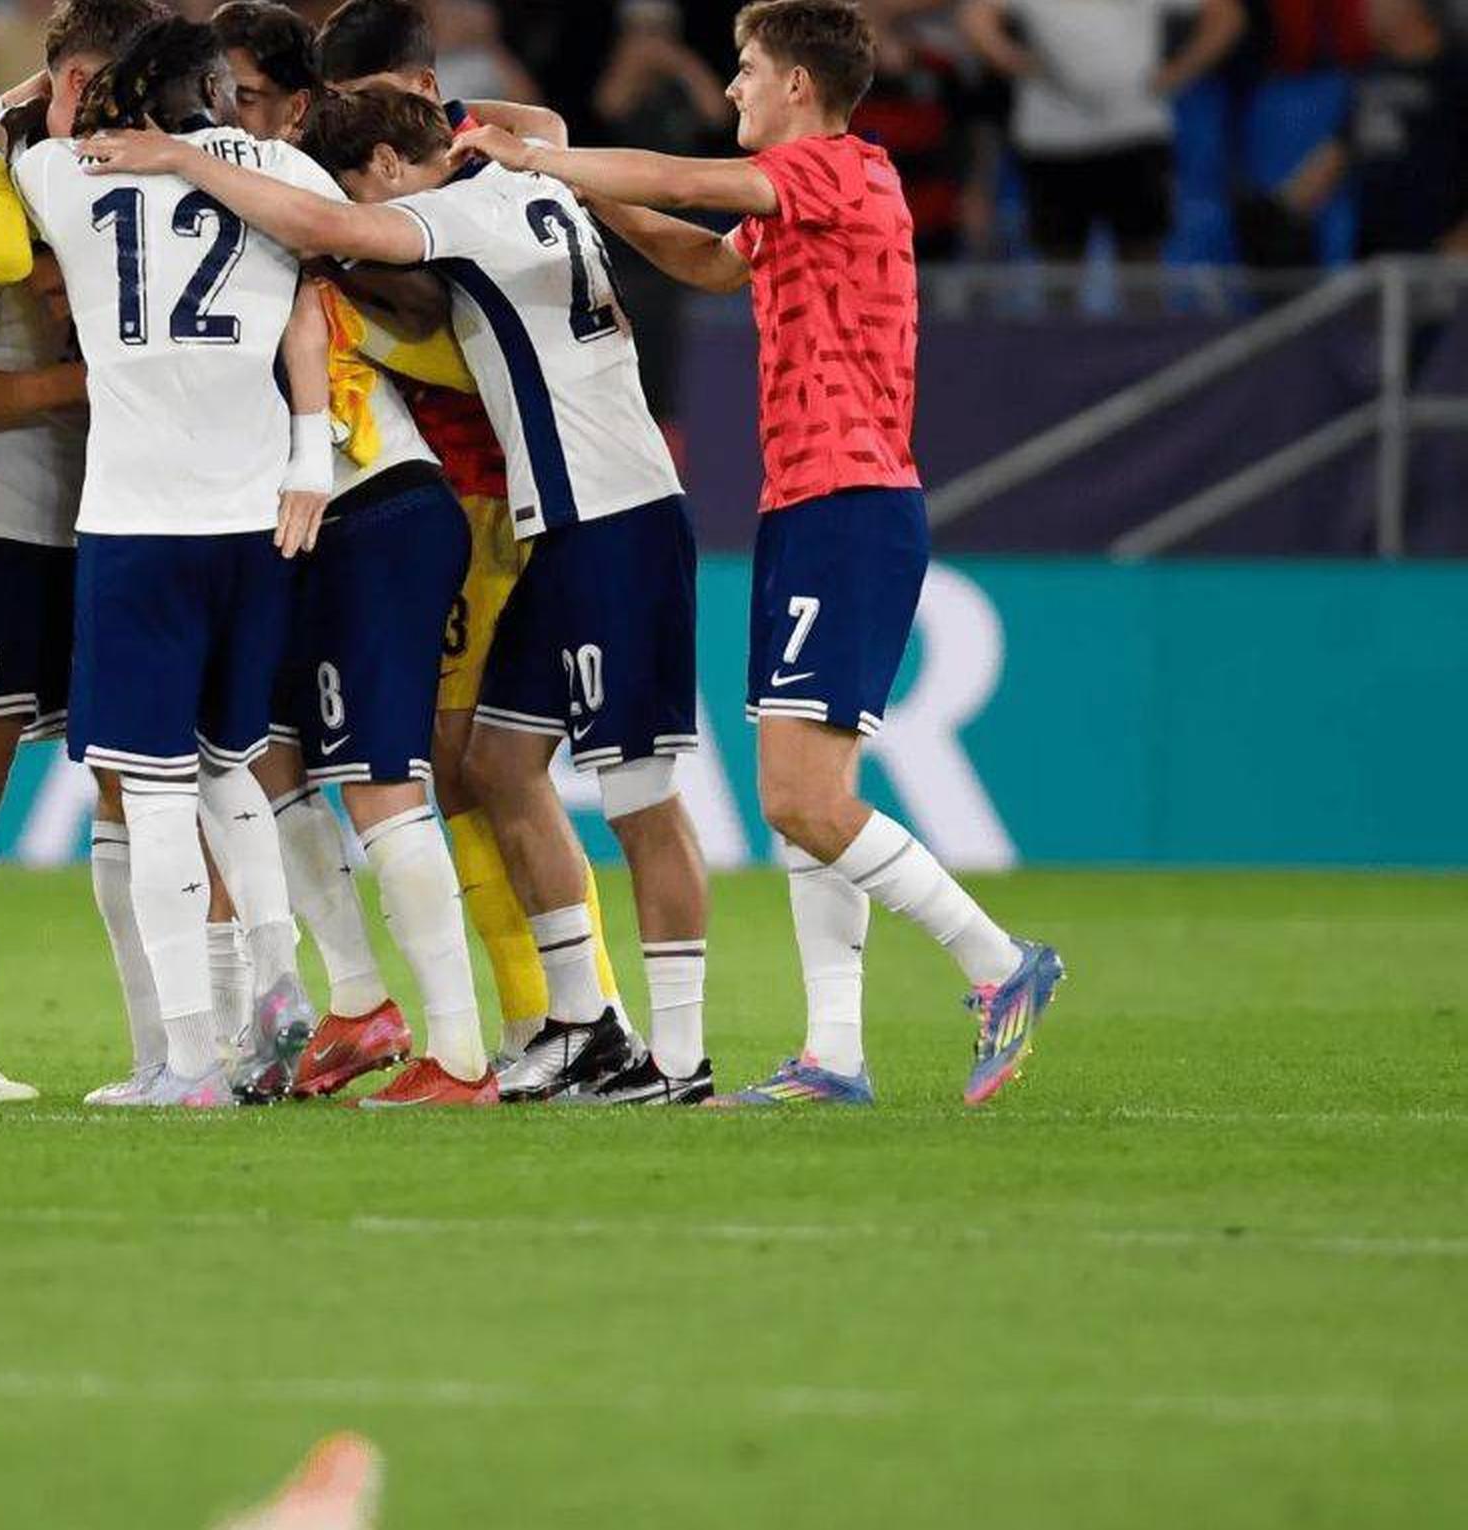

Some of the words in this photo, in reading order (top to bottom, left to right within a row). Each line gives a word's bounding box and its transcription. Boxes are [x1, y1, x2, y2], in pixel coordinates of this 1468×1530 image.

[92, 186, 248, 345] 12
[525, 198, 624, 343] 2
[783, 596, 821, 664] 7
[317, 660, 346, 730] 8
